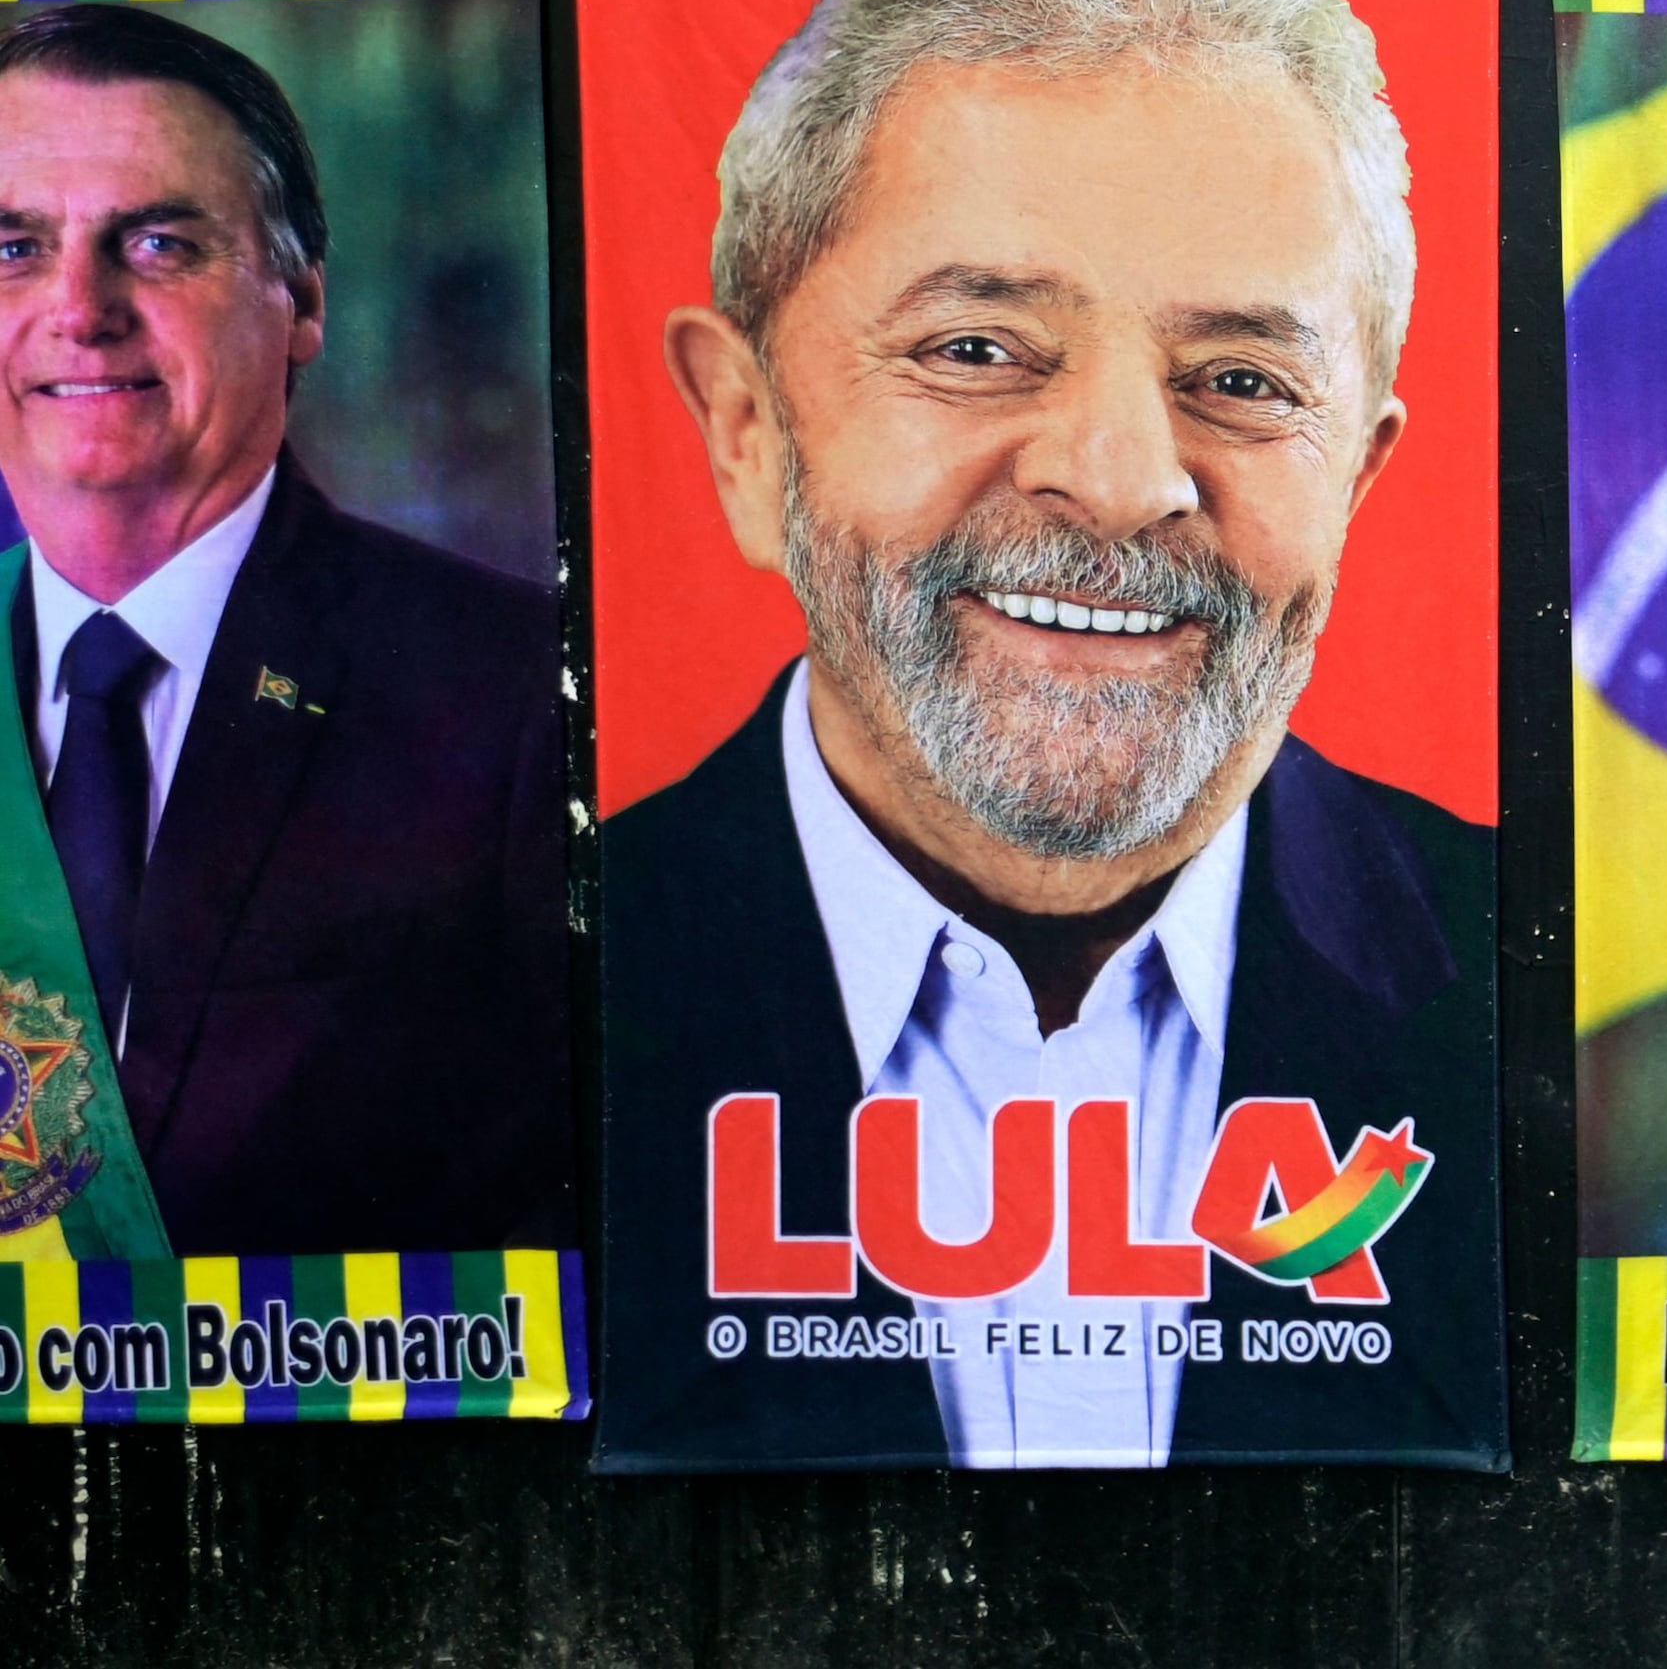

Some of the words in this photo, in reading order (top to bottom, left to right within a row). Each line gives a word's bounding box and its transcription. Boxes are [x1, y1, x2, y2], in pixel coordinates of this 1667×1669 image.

[708, 1092, 1392, 1305] LULA
[38, 1323, 168, 1392] com
[185, 1294, 528, 1387] Bolsonaro!
[710, 1318, 744, 1355] O
[769, 1319, 957, 1356] BRASIL
[986, 1321, 1128, 1356] FELIZ
[1156, 1322, 1220, 1358] DE
[1245, 1322, 1388, 1361] NOVO
